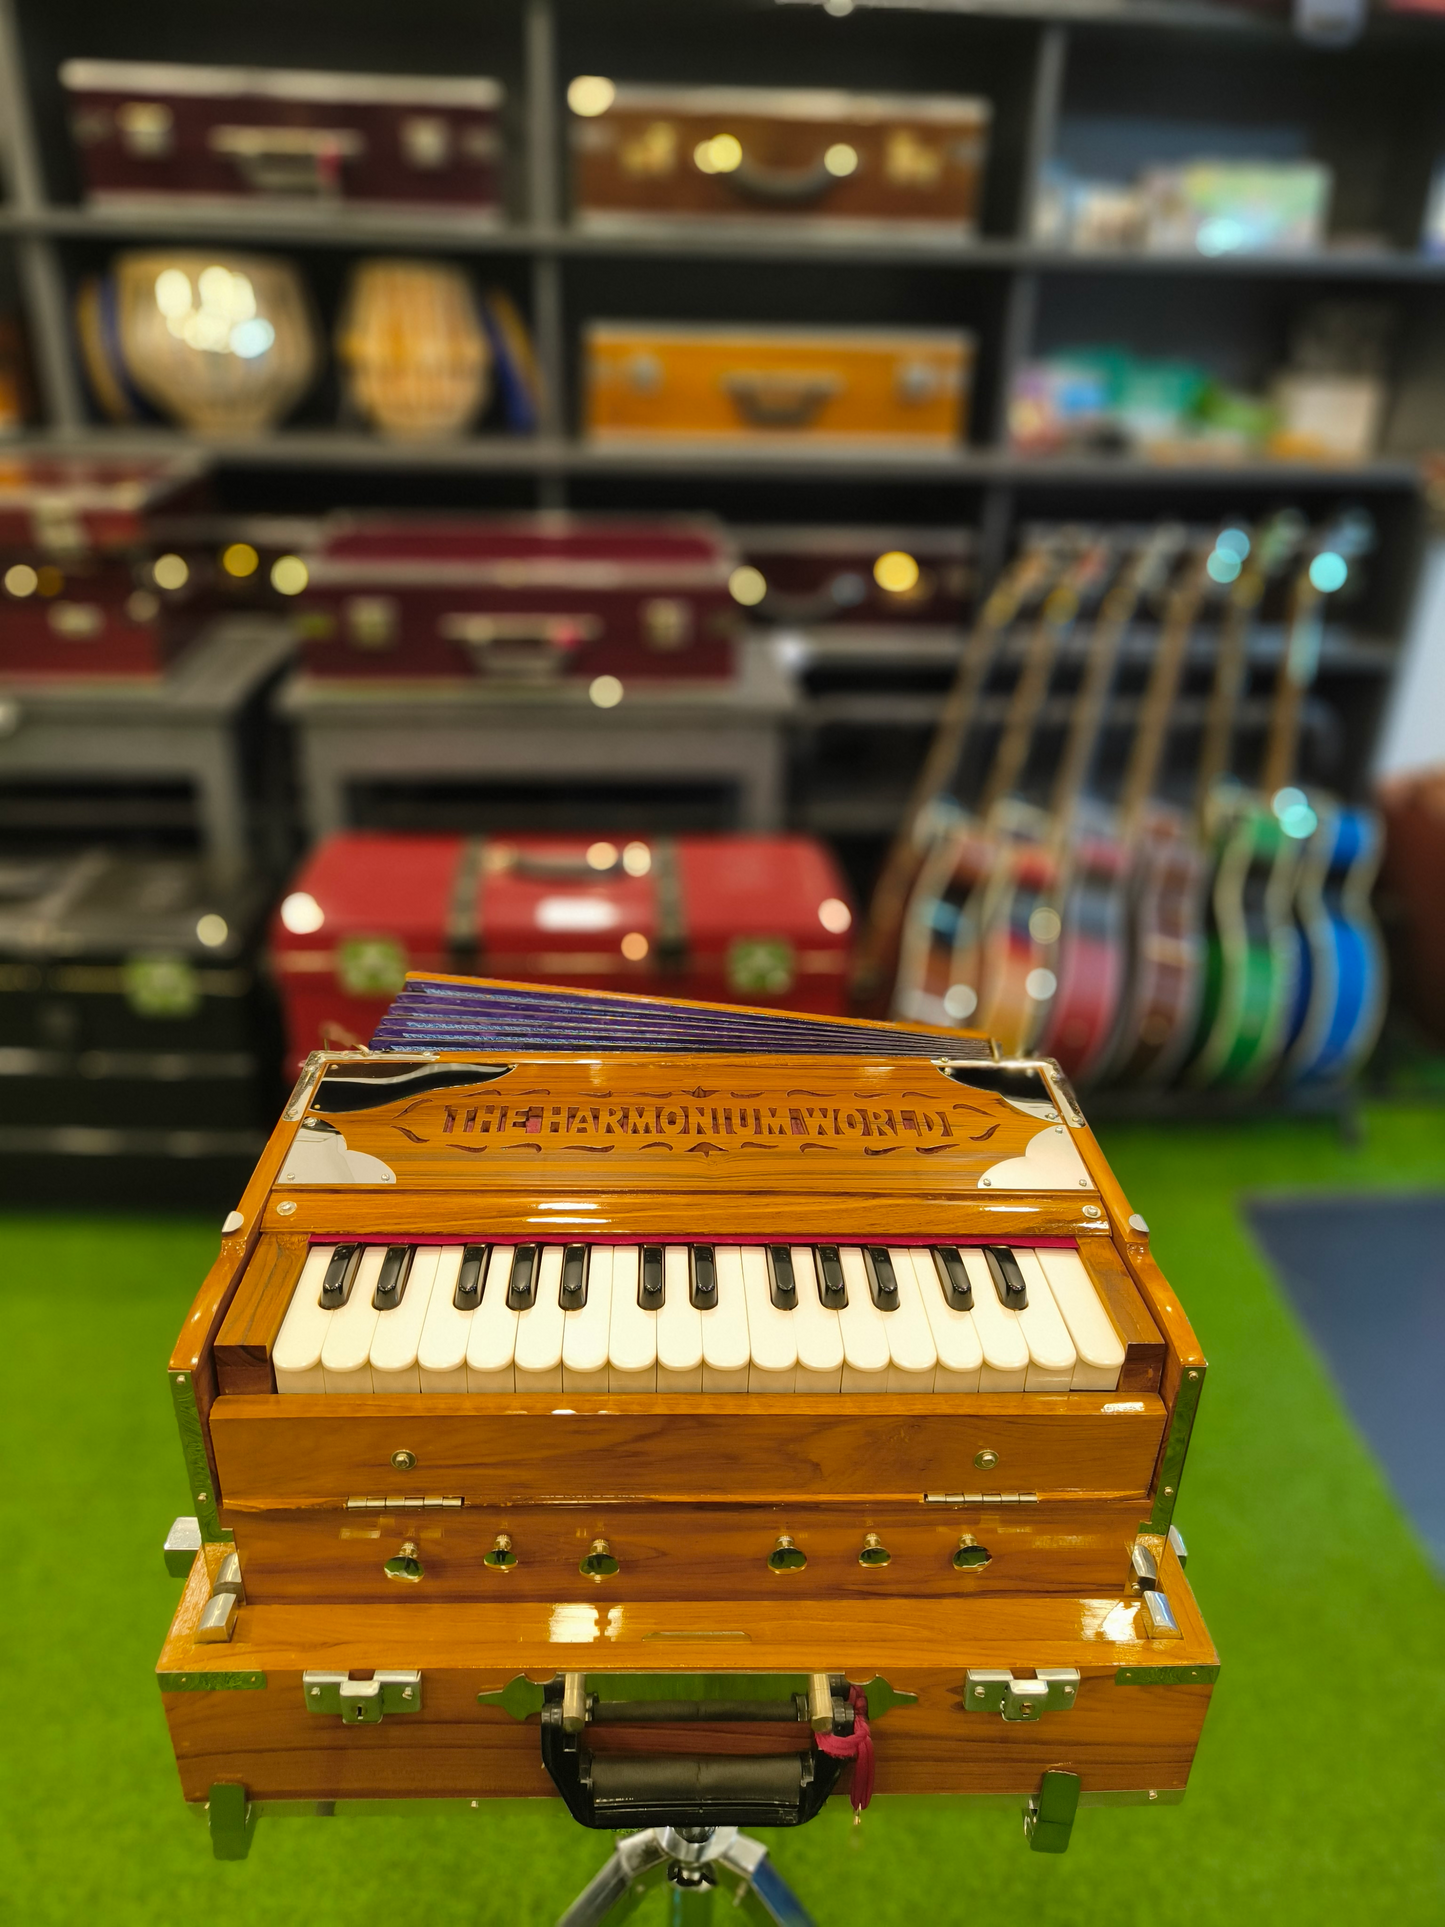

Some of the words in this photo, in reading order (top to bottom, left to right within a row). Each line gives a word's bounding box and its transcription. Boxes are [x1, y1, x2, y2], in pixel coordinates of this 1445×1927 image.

[443, 1106, 538, 1133] THE
[543, 1106, 791, 1135] HARMONIUM
[797, 1108, 953, 1136] WORLD
